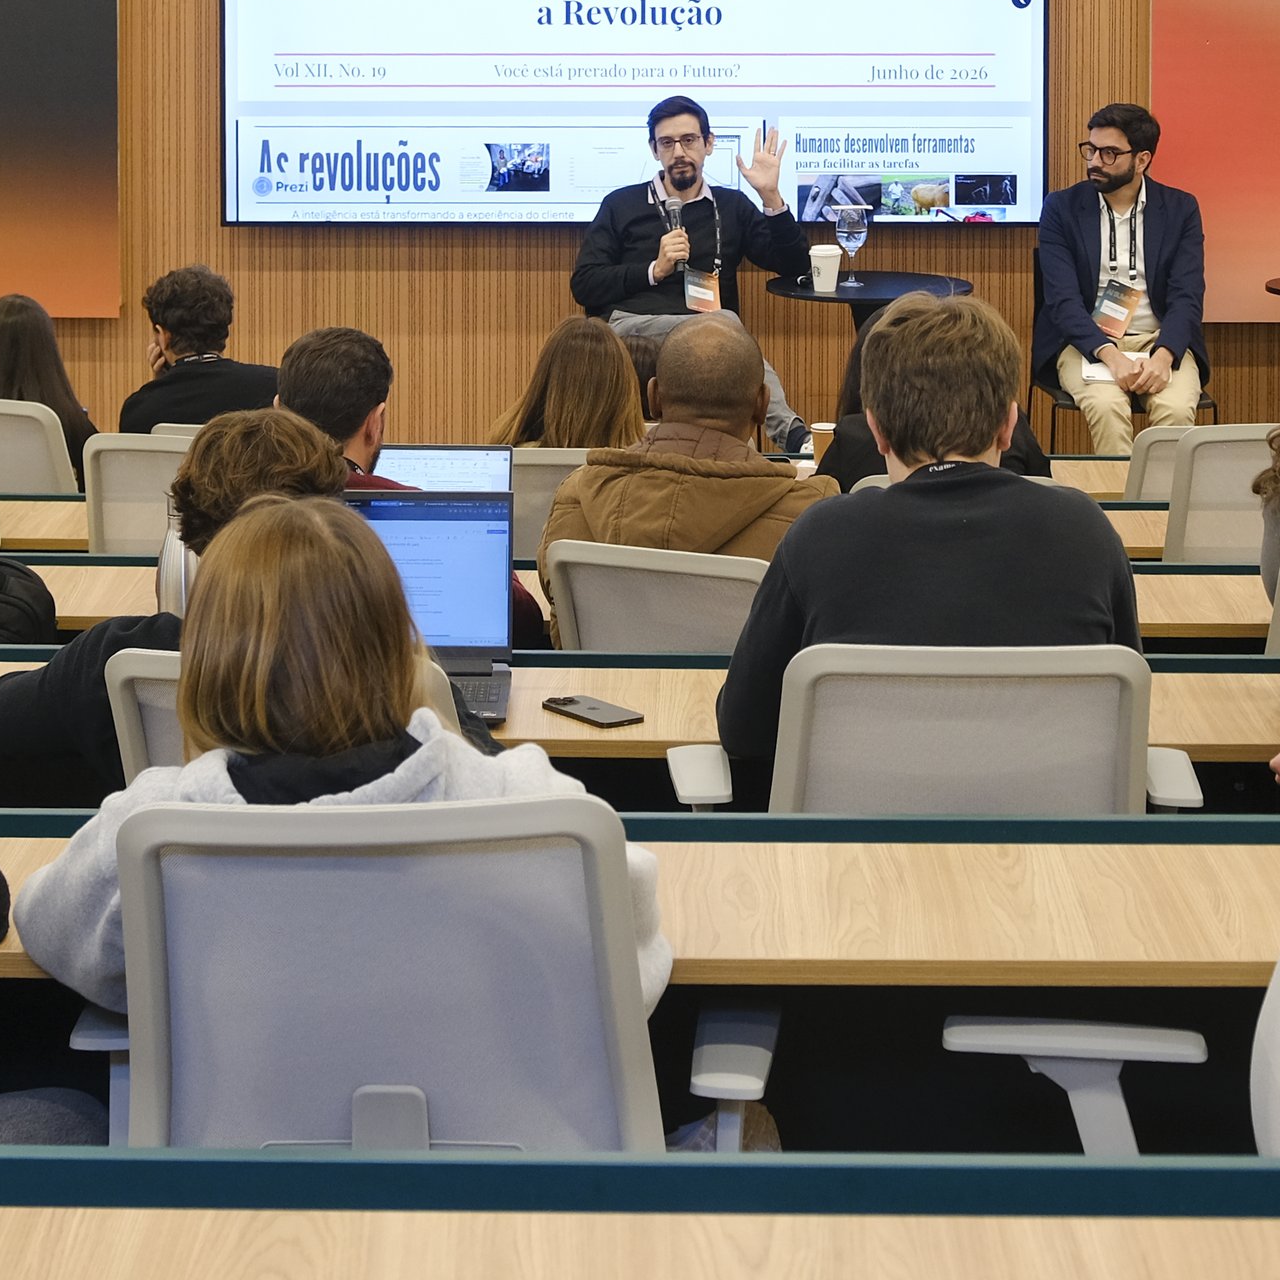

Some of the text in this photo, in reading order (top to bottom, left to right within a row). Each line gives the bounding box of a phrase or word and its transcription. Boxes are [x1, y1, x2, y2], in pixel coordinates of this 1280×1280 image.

[537, 6, 553, 26] a
[273, 62, 299, 78] Vol
[339, 63, 365, 78] No.
[372, 67, 387, 79] 19
[493, 63, 741, 80] Você está prerado para o Futuro?
[867, 64, 988, 82] Junho de 2026
[795, 132, 976, 154] Humanos desenvolvem ferramentas
[299, 139, 441, 204] revoluções
[795, 160, 820, 170] para
[823, 158, 866, 169] facilitar
[868, 160, 880, 169] as
[275, 181, 309, 193] Prezi
[291, 209, 300, 219] A
[302, 209, 358, 220] inteligência
[360, 209, 380, 219] está
[383, 209, 456, 219] transformando
[466, 209, 524, 220] experiência
[525, 209, 539, 219] do
[542, 209, 575, 219] cliente
